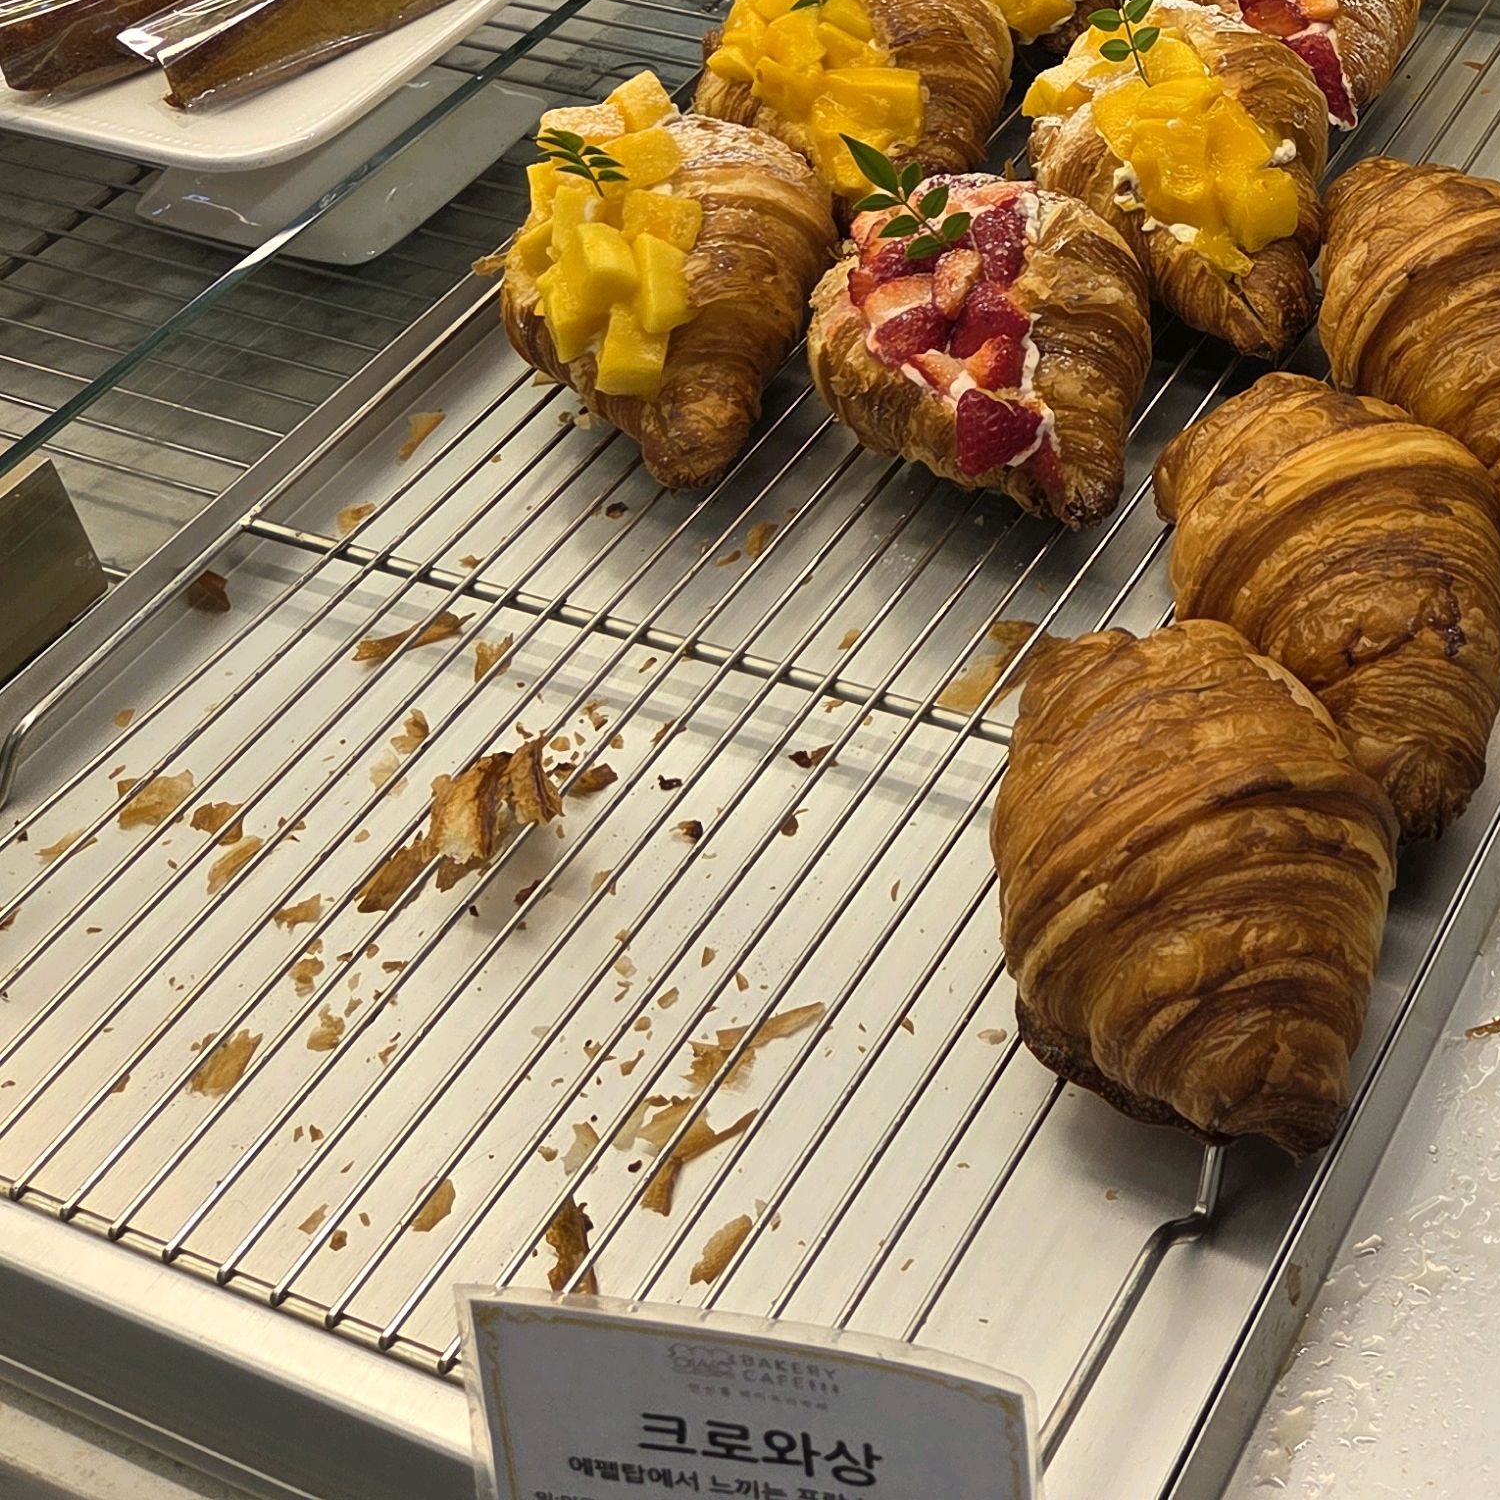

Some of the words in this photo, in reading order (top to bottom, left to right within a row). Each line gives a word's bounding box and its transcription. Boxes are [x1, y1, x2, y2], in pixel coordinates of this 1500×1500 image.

[740, 1354, 837, 1380] BAKERY
[743, 1368, 804, 1390] CAFE
[638, 1411, 884, 1487] 크로와상
[709, 1475, 788, 1500] 느끼는
